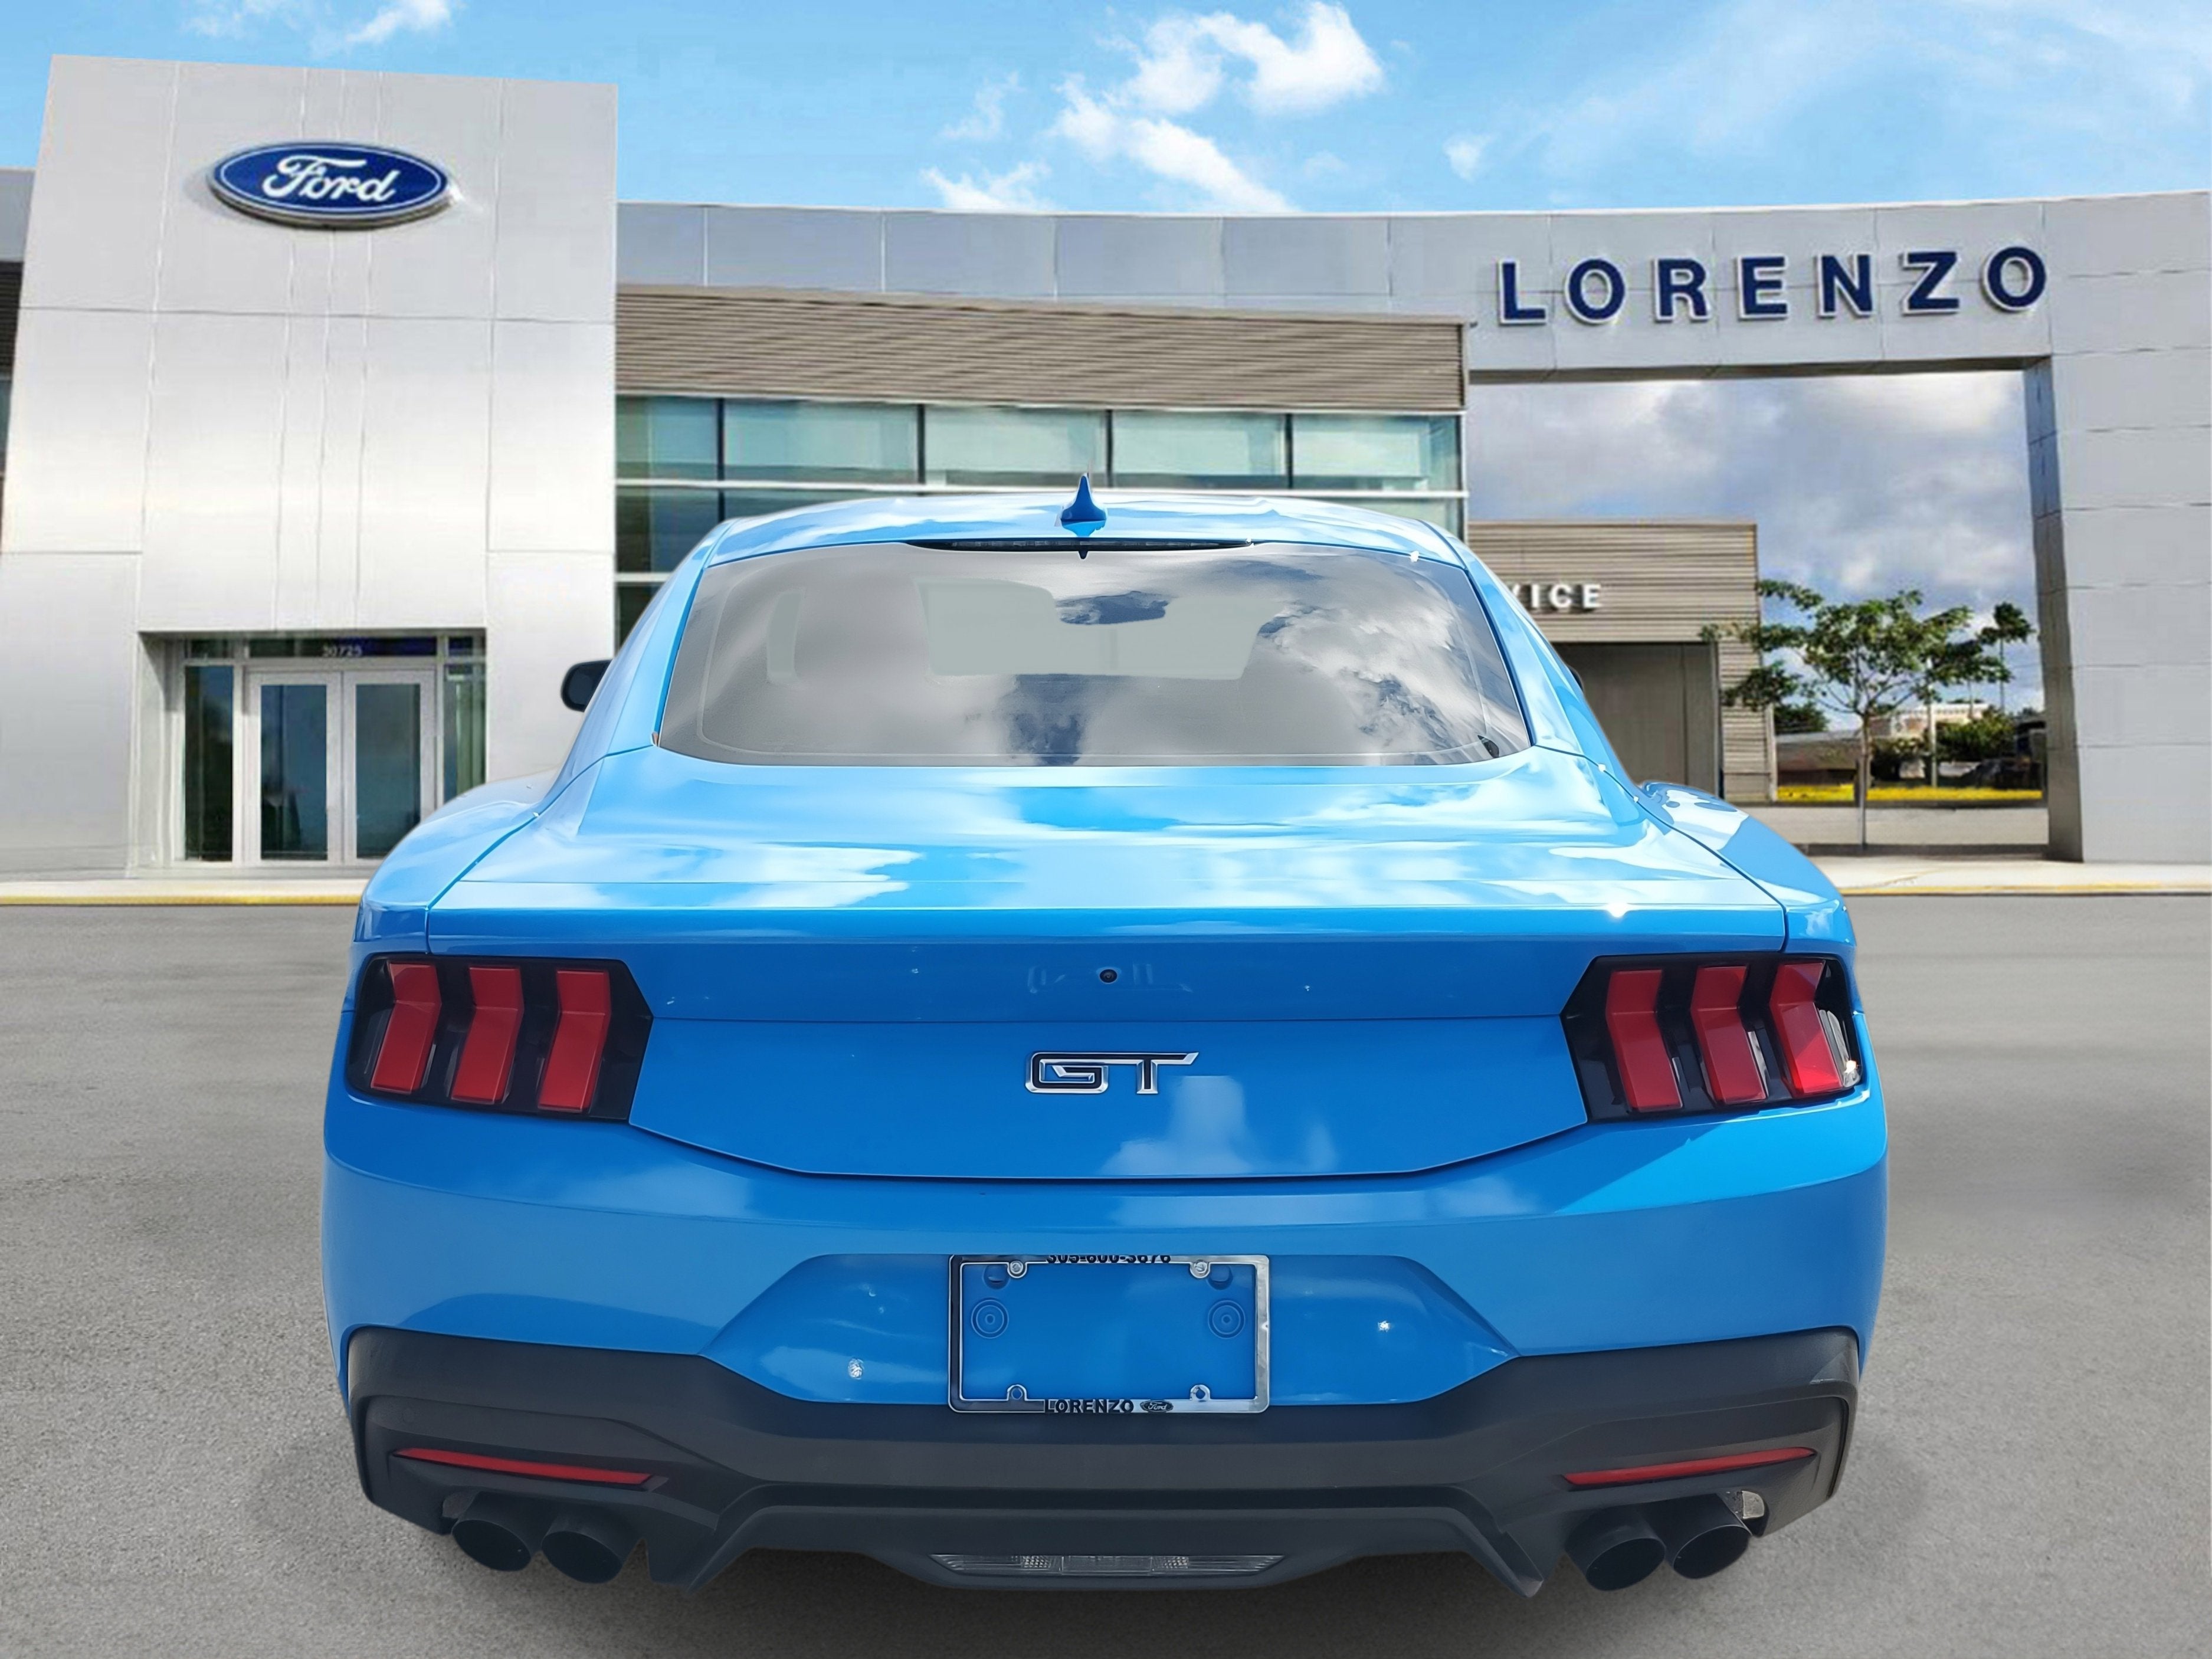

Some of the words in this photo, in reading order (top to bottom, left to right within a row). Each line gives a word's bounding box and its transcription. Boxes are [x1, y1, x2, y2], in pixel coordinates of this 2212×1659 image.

[263, 155, 400, 201] Ford
[1498, 247, 2047, 323] LORENZO
[1025, 1052, 1199, 1094] GT
[1045, 1399, 1134, 1413] LORENZO
